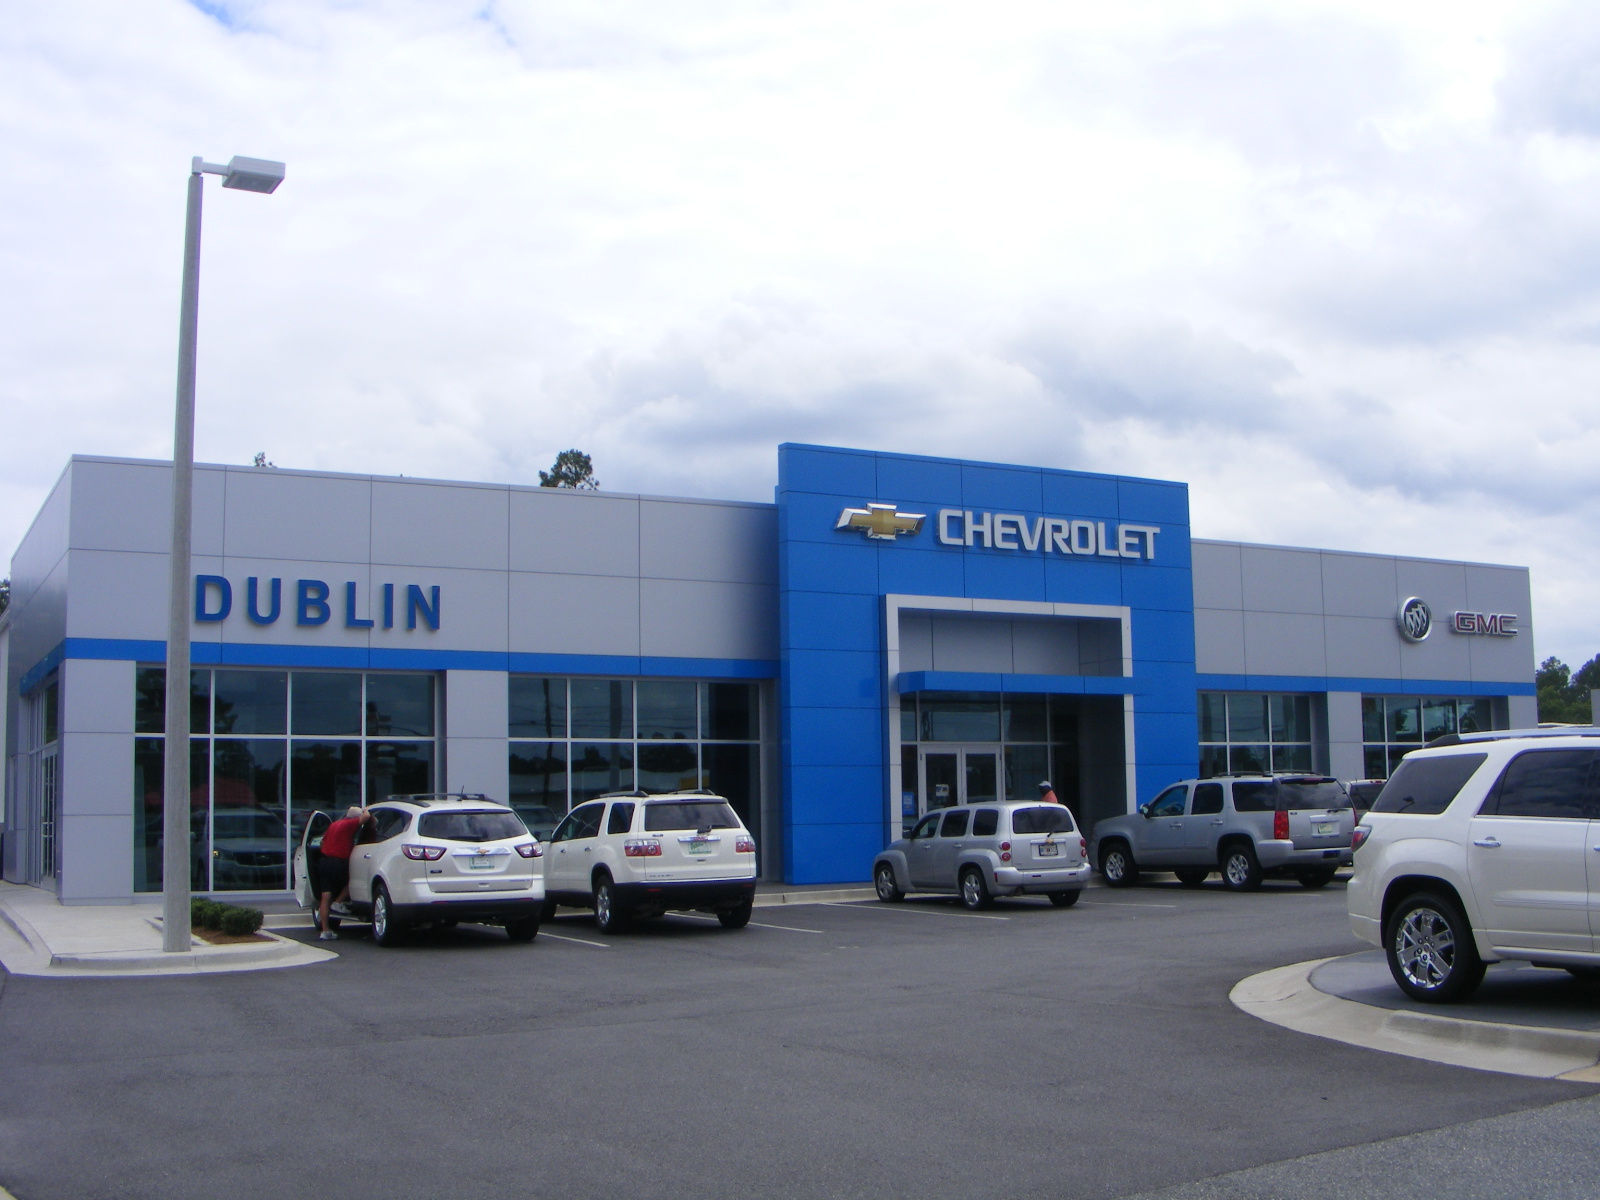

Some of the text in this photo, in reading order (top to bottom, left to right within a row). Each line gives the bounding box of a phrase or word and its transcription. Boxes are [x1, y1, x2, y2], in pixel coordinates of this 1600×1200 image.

[938, 508, 1160, 560] CHEVROLET
[195, 575, 441, 631] DUBLIN
[1454, 610, 1518, 636] GMC
